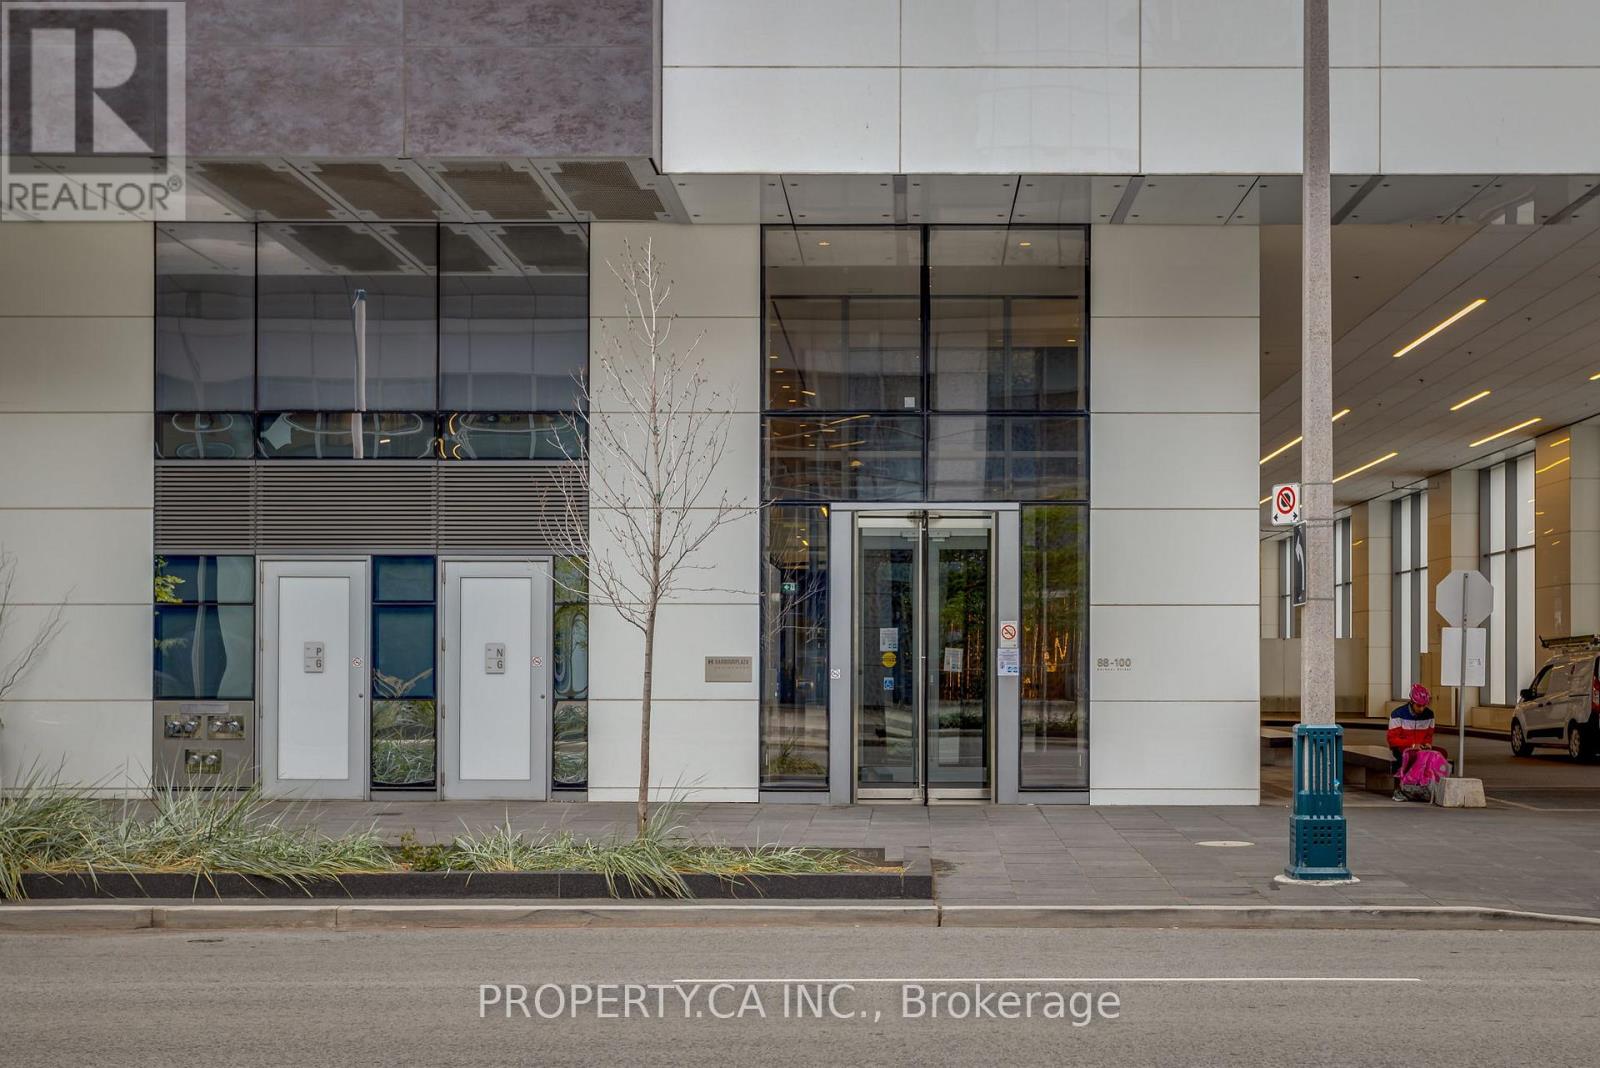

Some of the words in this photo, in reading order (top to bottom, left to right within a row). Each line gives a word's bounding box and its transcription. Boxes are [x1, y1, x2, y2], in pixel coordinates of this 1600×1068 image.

[316, 647, 322, 656] P
[496, 648, 504, 658] N
[316, 659, 322, 668] G
[496, 660, 503, 669] G
[1097, 658, 1131, 667] 88-100
